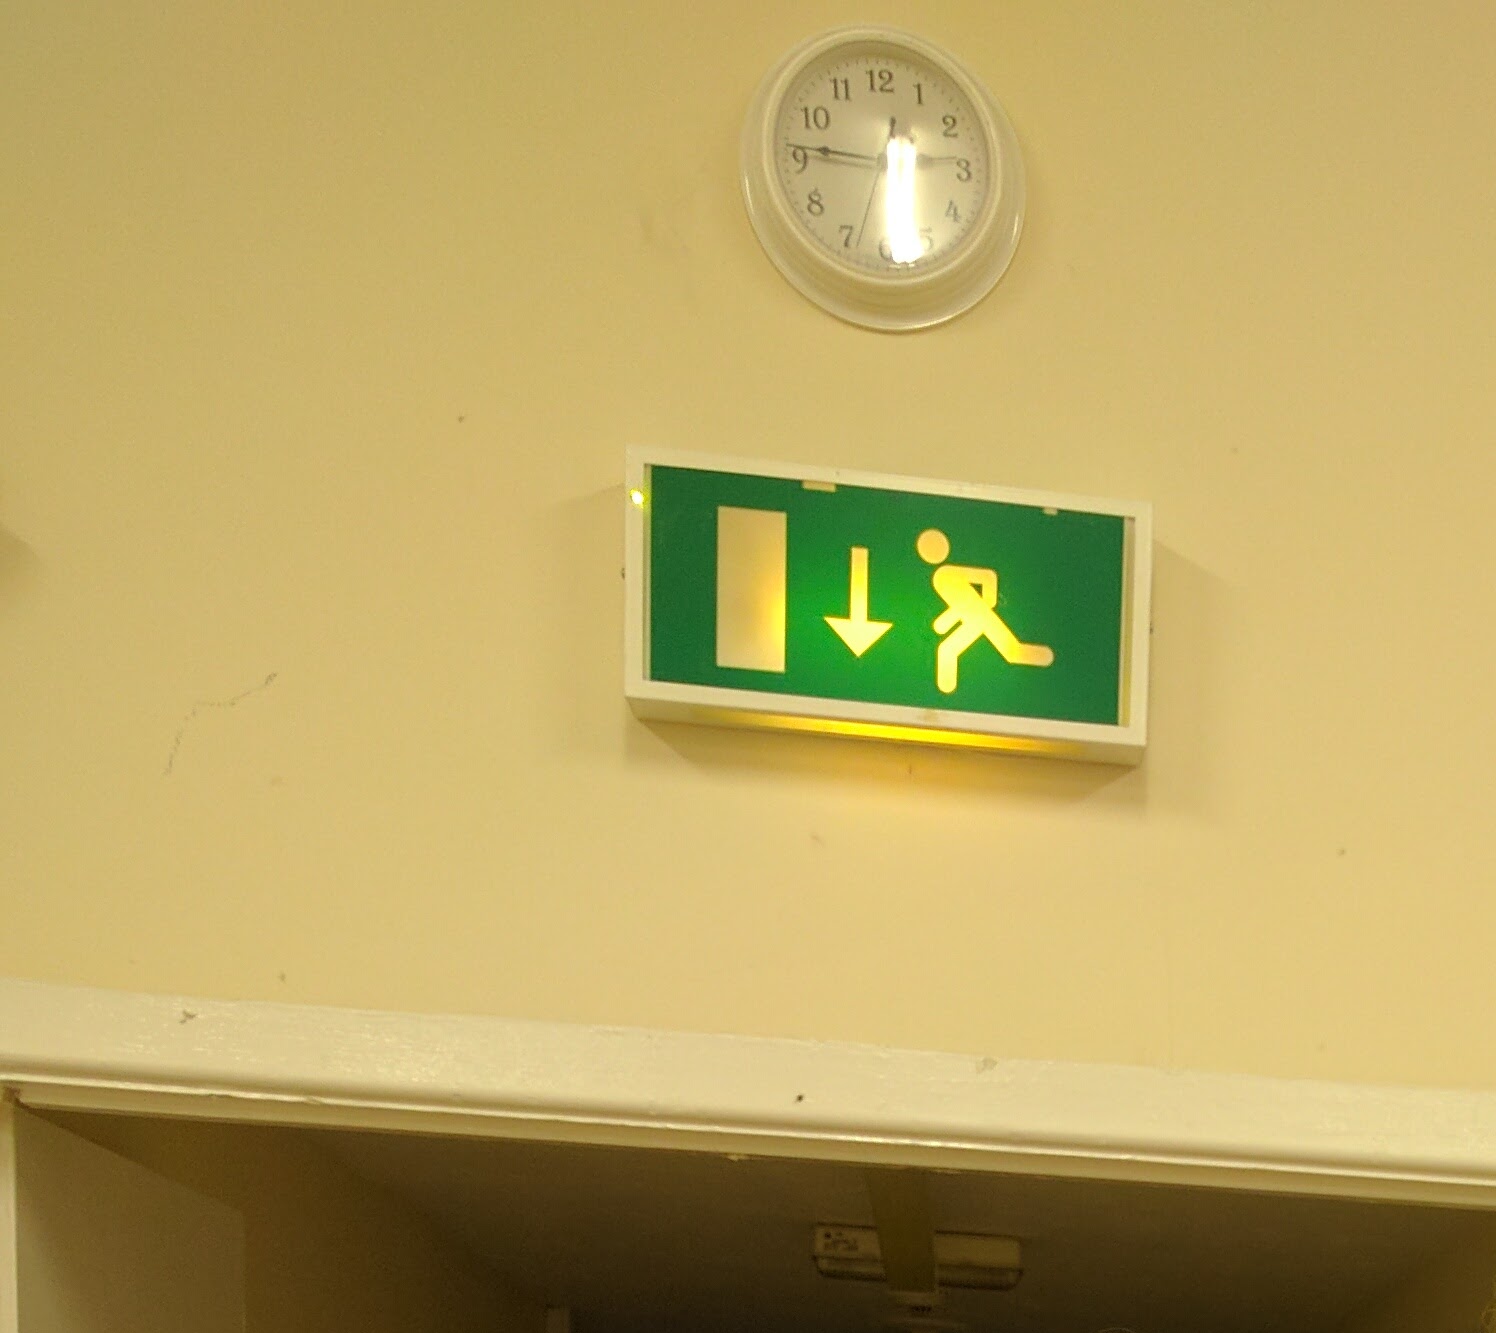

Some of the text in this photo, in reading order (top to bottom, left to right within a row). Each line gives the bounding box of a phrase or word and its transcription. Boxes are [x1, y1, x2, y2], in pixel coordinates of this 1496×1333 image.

[830, 77, 851, 101] 11
[866, 69, 895, 93] 12
[913, 83, 923, 105] 1
[801, 106, 830, 130] 10
[942, 115, 958, 137] 2
[792, 147, 807, 174] 9
[956, 158, 972, 182] 3
[807, 187, 824, 216] 8
[945, 200, 961, 223] 4
[838, 224, 853, 248] 7
